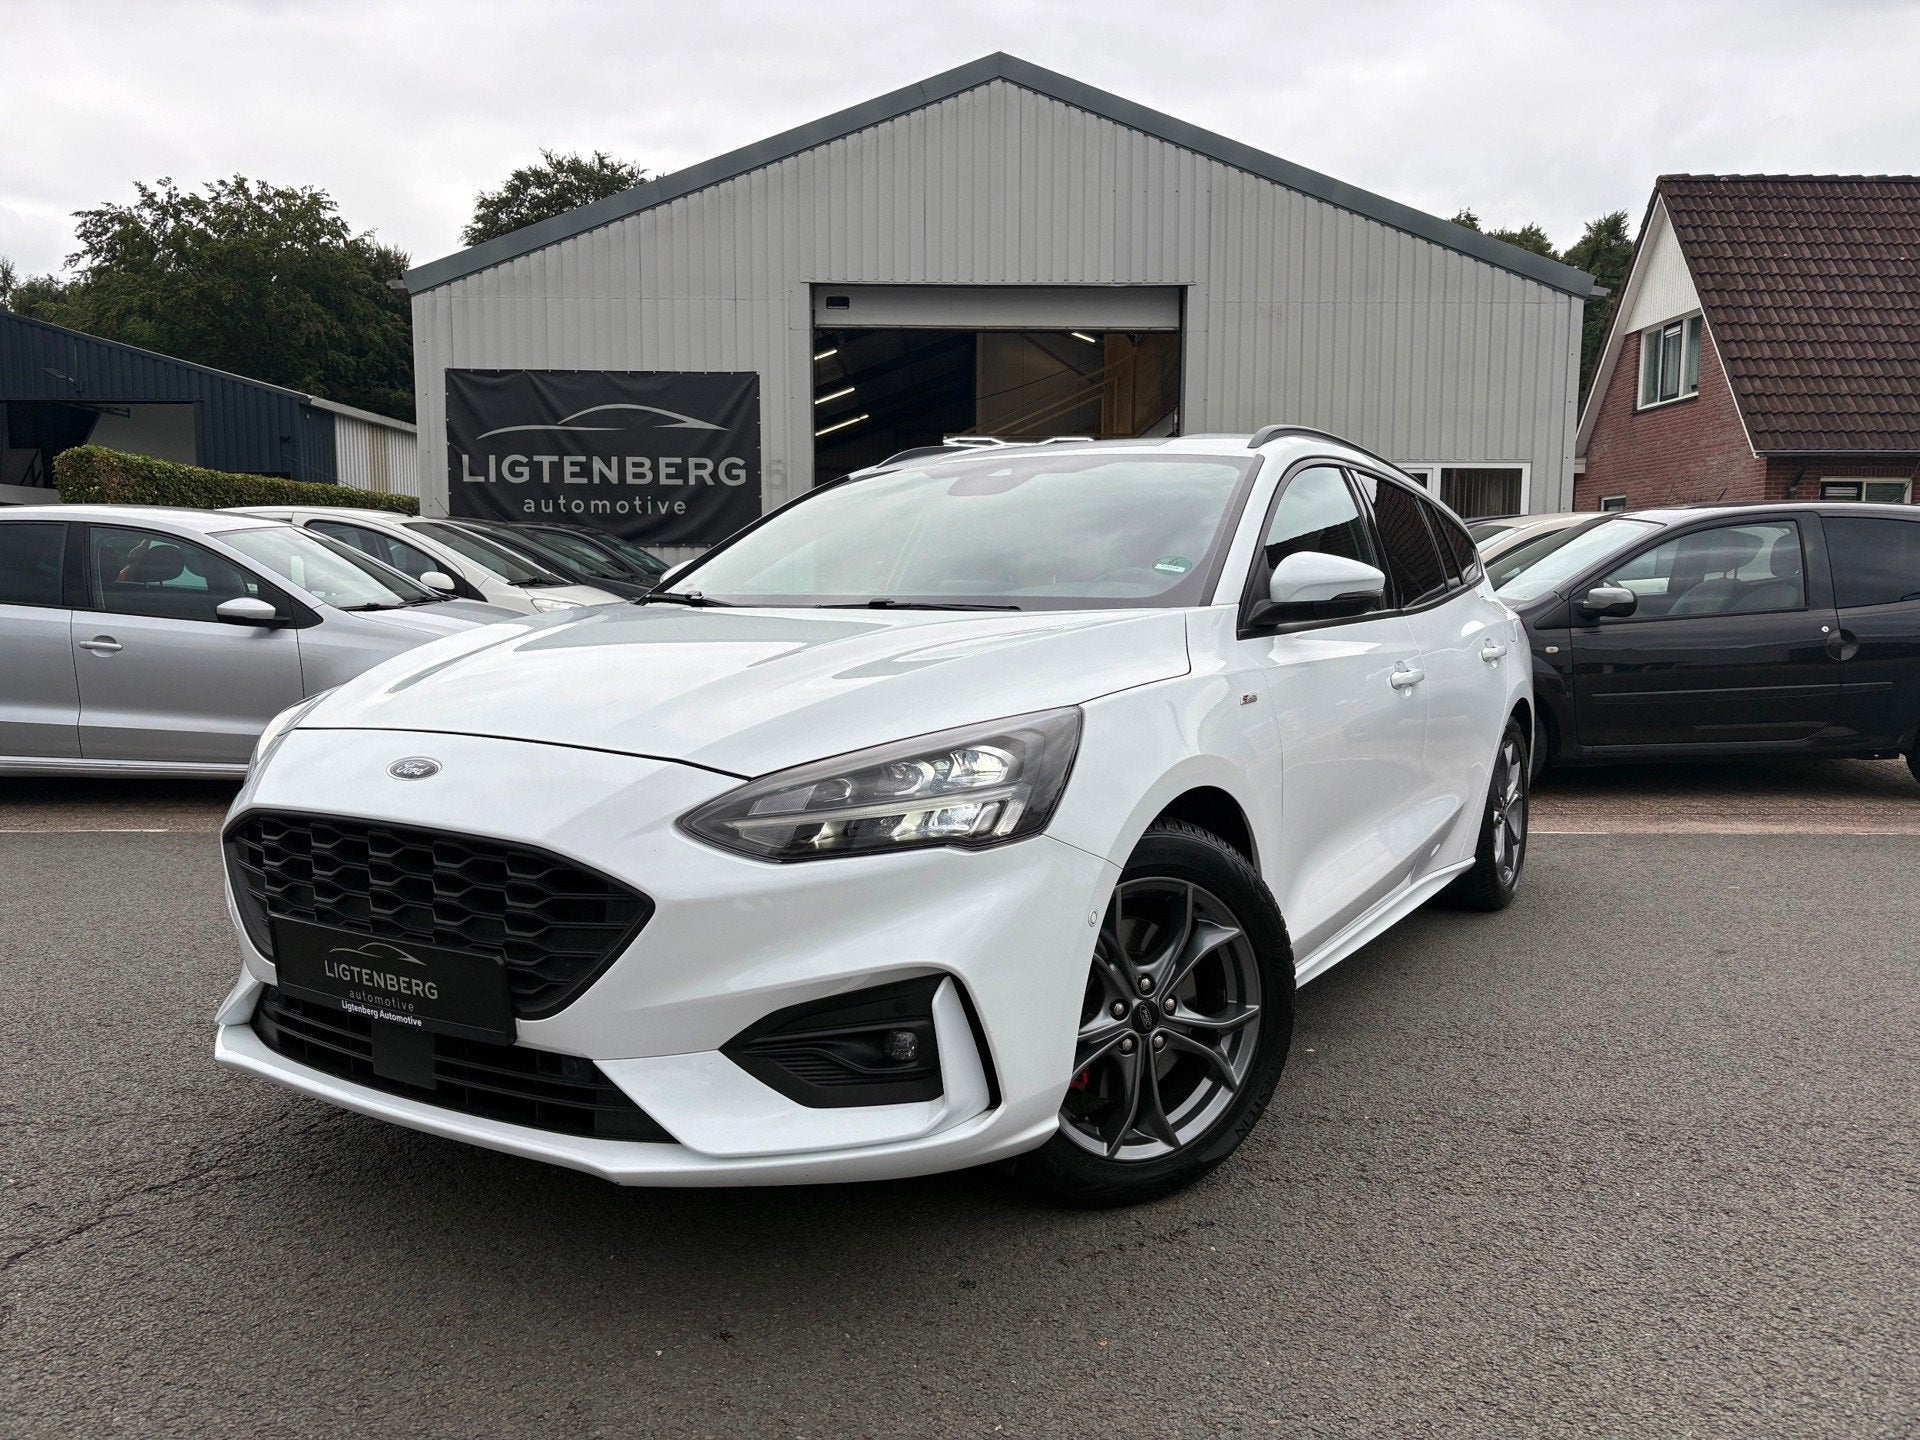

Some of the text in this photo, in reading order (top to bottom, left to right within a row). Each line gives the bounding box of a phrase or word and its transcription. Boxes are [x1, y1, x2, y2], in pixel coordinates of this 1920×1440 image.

[461, 453, 747, 487] LIGTENBERG
[523, 494, 687, 515] automotive
[324, 959, 439, 1000] LIGTENBERG
[341, 1000, 422, 1027] Ligtenberg Automotive
[349, 988, 414, 1012] automotive
